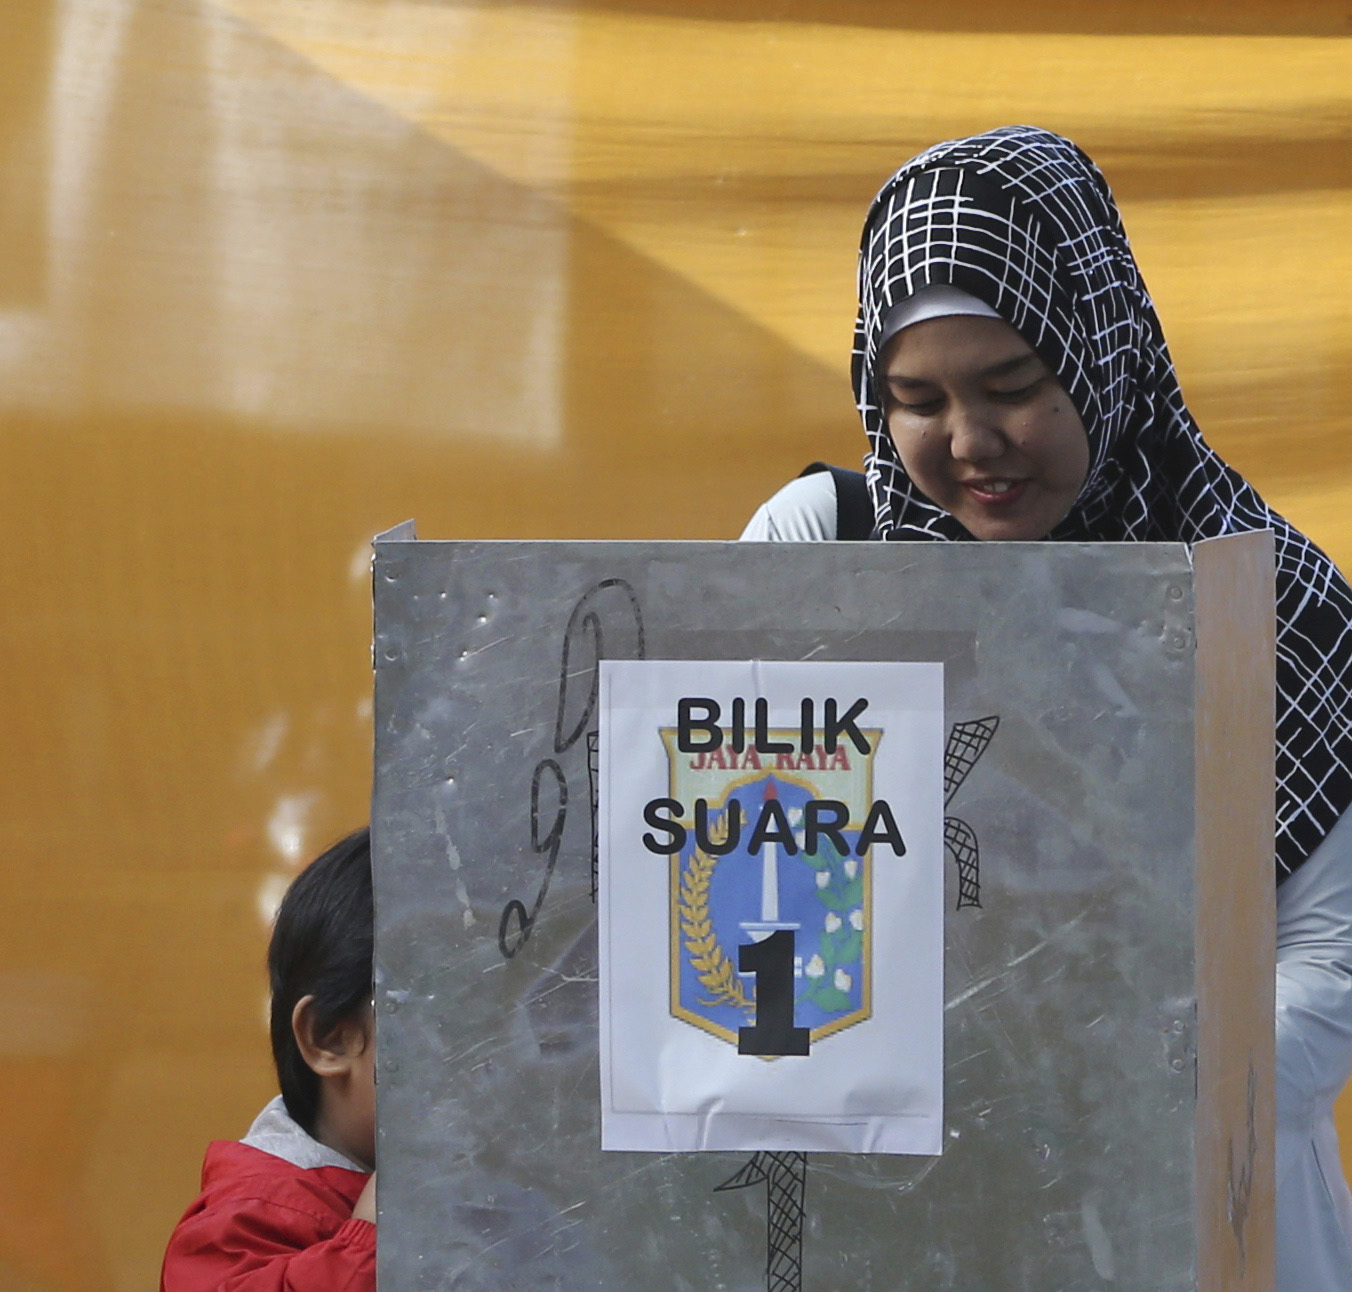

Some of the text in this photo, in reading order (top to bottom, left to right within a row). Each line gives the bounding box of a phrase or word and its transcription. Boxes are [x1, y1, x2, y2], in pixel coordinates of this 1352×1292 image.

[677, 697, 871, 755] BILIK
[690, 744, 762, 770] JAYA
[642, 798, 906, 857] SUARA
[738, 930, 810, 1056] 1
